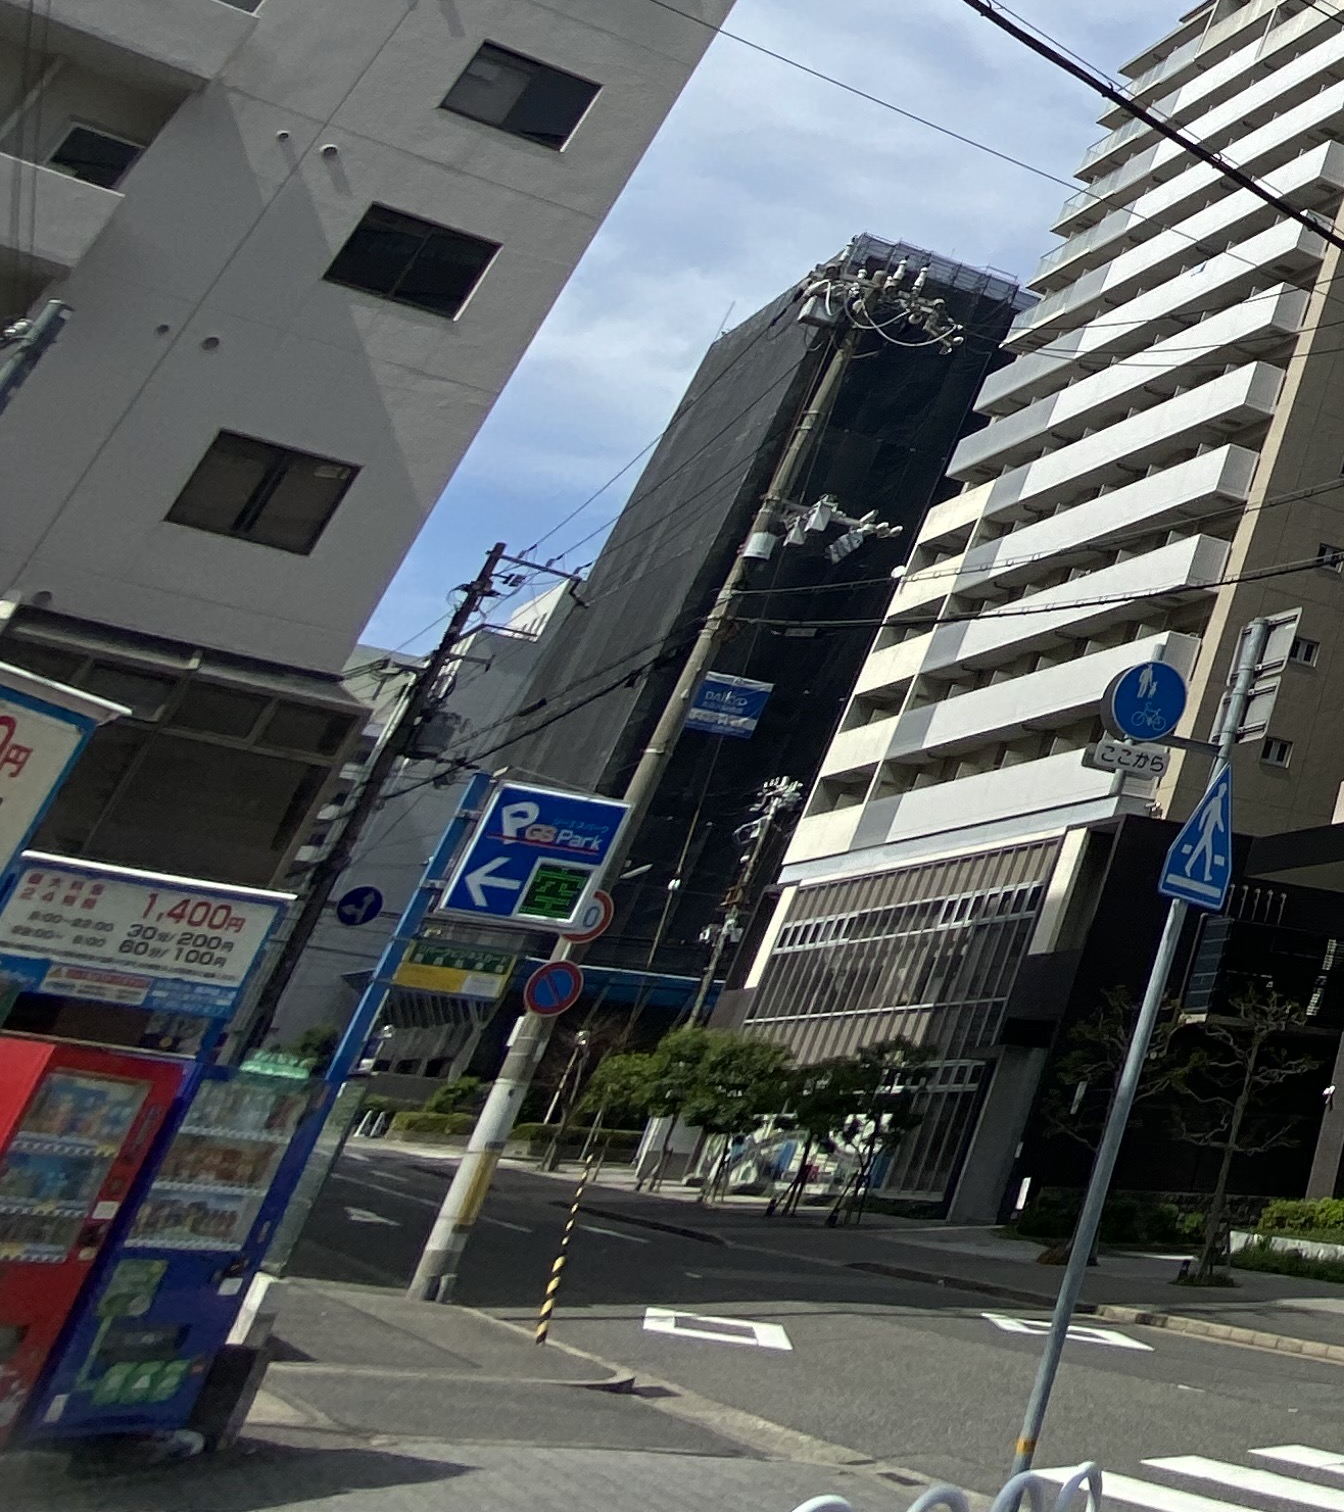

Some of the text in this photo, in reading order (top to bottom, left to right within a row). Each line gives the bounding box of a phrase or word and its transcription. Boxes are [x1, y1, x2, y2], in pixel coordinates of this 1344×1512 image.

[1102, 745, 1164, 773] ここから
[555, 829, 602, 851] Park
[141, 892, 247, 934] 1,400円
